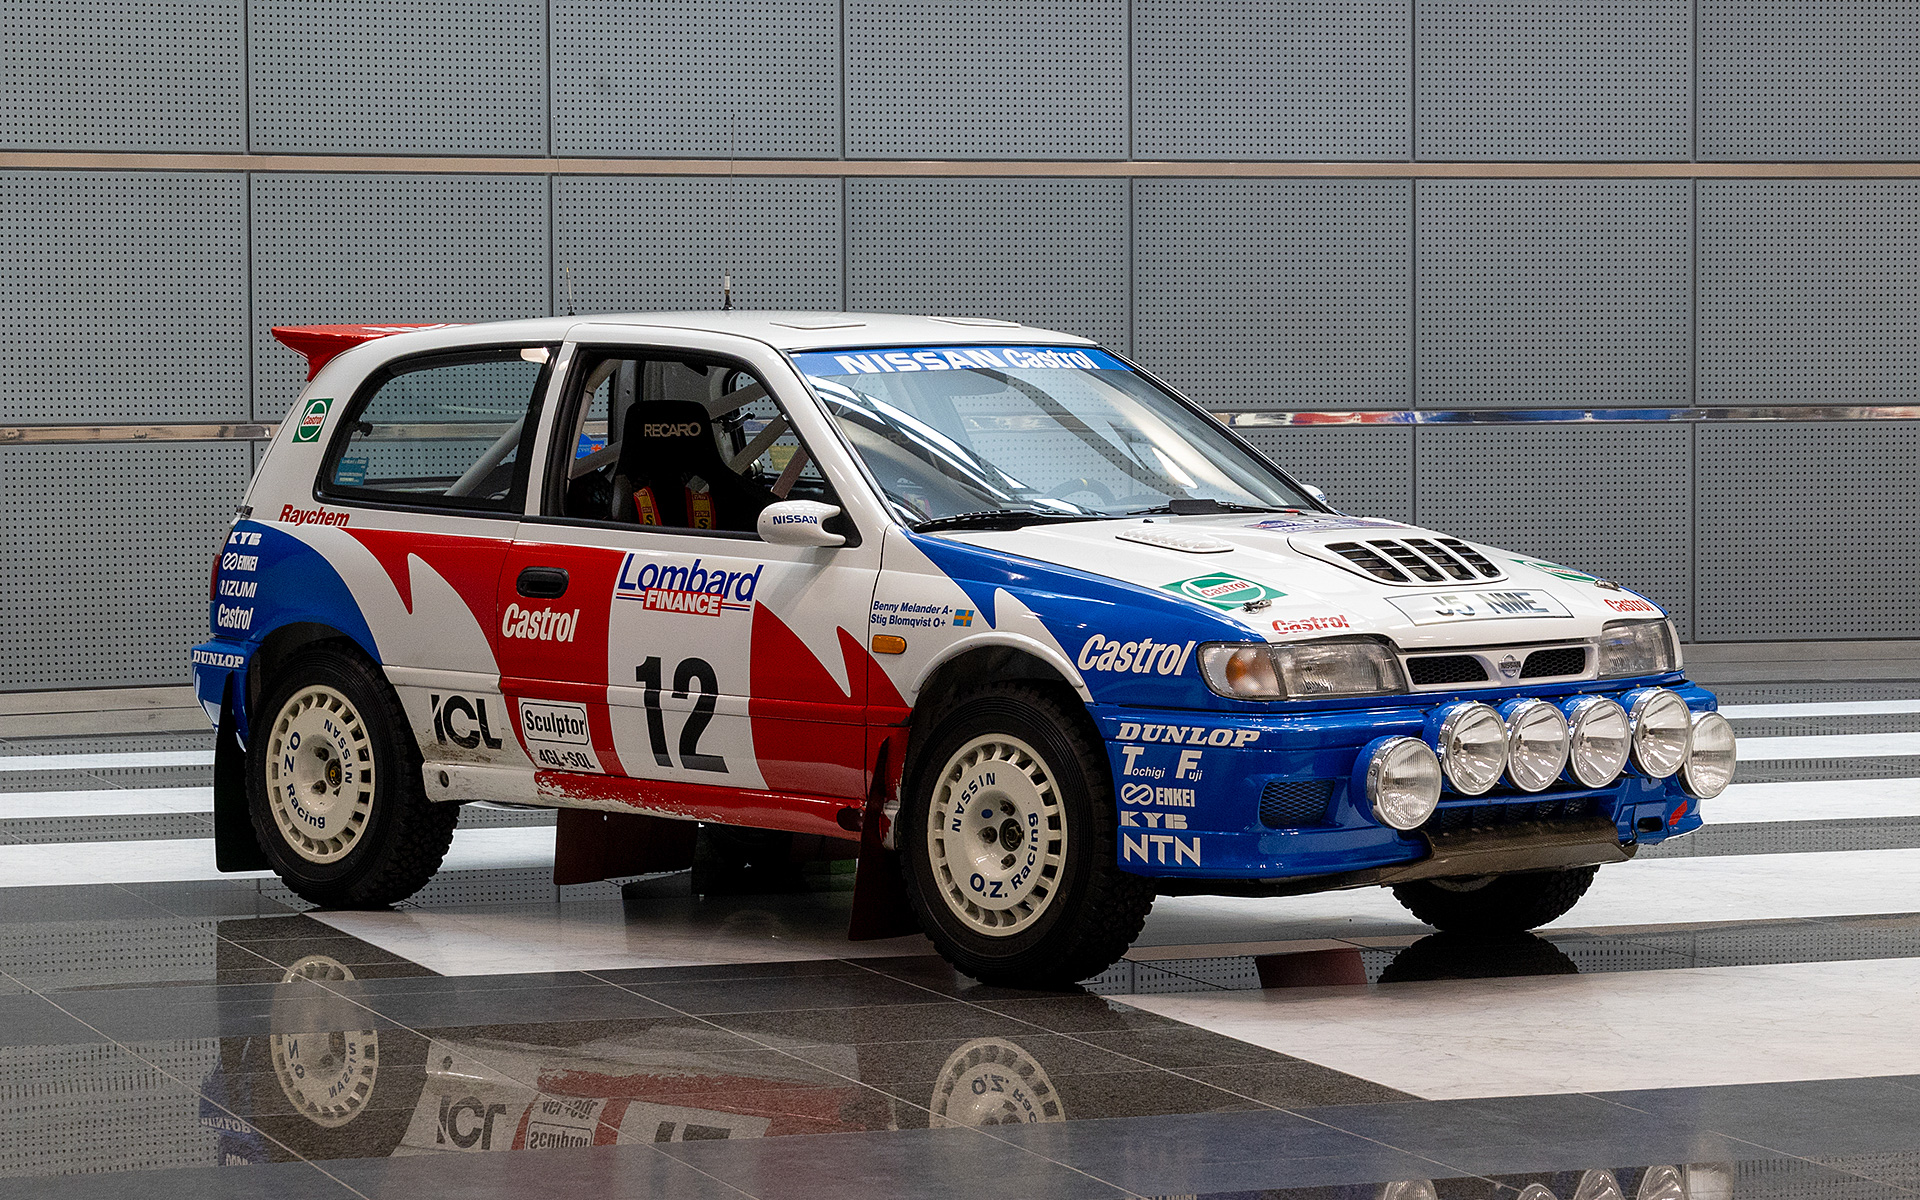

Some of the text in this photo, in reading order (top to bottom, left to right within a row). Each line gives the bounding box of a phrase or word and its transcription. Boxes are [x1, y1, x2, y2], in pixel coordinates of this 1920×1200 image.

[834, 348, 1100, 374] NISSAN Castrol
[303, 413, 324, 427] Castrol
[644, 421, 701, 437] RECARO
[278, 504, 350, 527] Raychem
[772, 515, 818, 525] NISSAN
[228, 531, 262, 546] KYB
[237, 555, 258, 571] ENKEI
[617, 553, 764, 602] Lombard
[645, 590, 722, 614] FINANCE
[1200, 581, 1250, 599] Castrol
[873, 601, 953, 615] Benny Melander A-
[1435, 592, 1550, 616] J5 NME
[1603, 598, 1654, 612] Castrol
[218, 603, 254, 630] Castrol
[502, 602, 580, 642] Castrol
[870, 613, 886, 626] Stig
[889, 615, 931, 628] Blomqvist
[1272, 614, 1349, 635] Castrol
[192, 650, 244, 668] DUNLOP
[1078, 634, 1196, 676] Castrol
[431, 694, 503, 750] ICL
[525, 710, 585, 738] Sculptor
[635, 656, 730, 774] 12
[1116, 722, 1260, 748] DUNLOP
[323, 719, 353, 784] NISSAN
[539, 749, 596, 770] 4GL+SQL
[1123, 746, 1202, 781] Tochigi Fuji
[283, 731, 326, 829] O.Z. Racing
[952, 772, 996, 833] NISSAN
[1155, 787, 1196, 808] ENKEI
[1120, 811, 1188, 830] KYB
[969, 812, 1039, 899] O.Z. Racing
[1123, 833, 1201, 867] NTN
